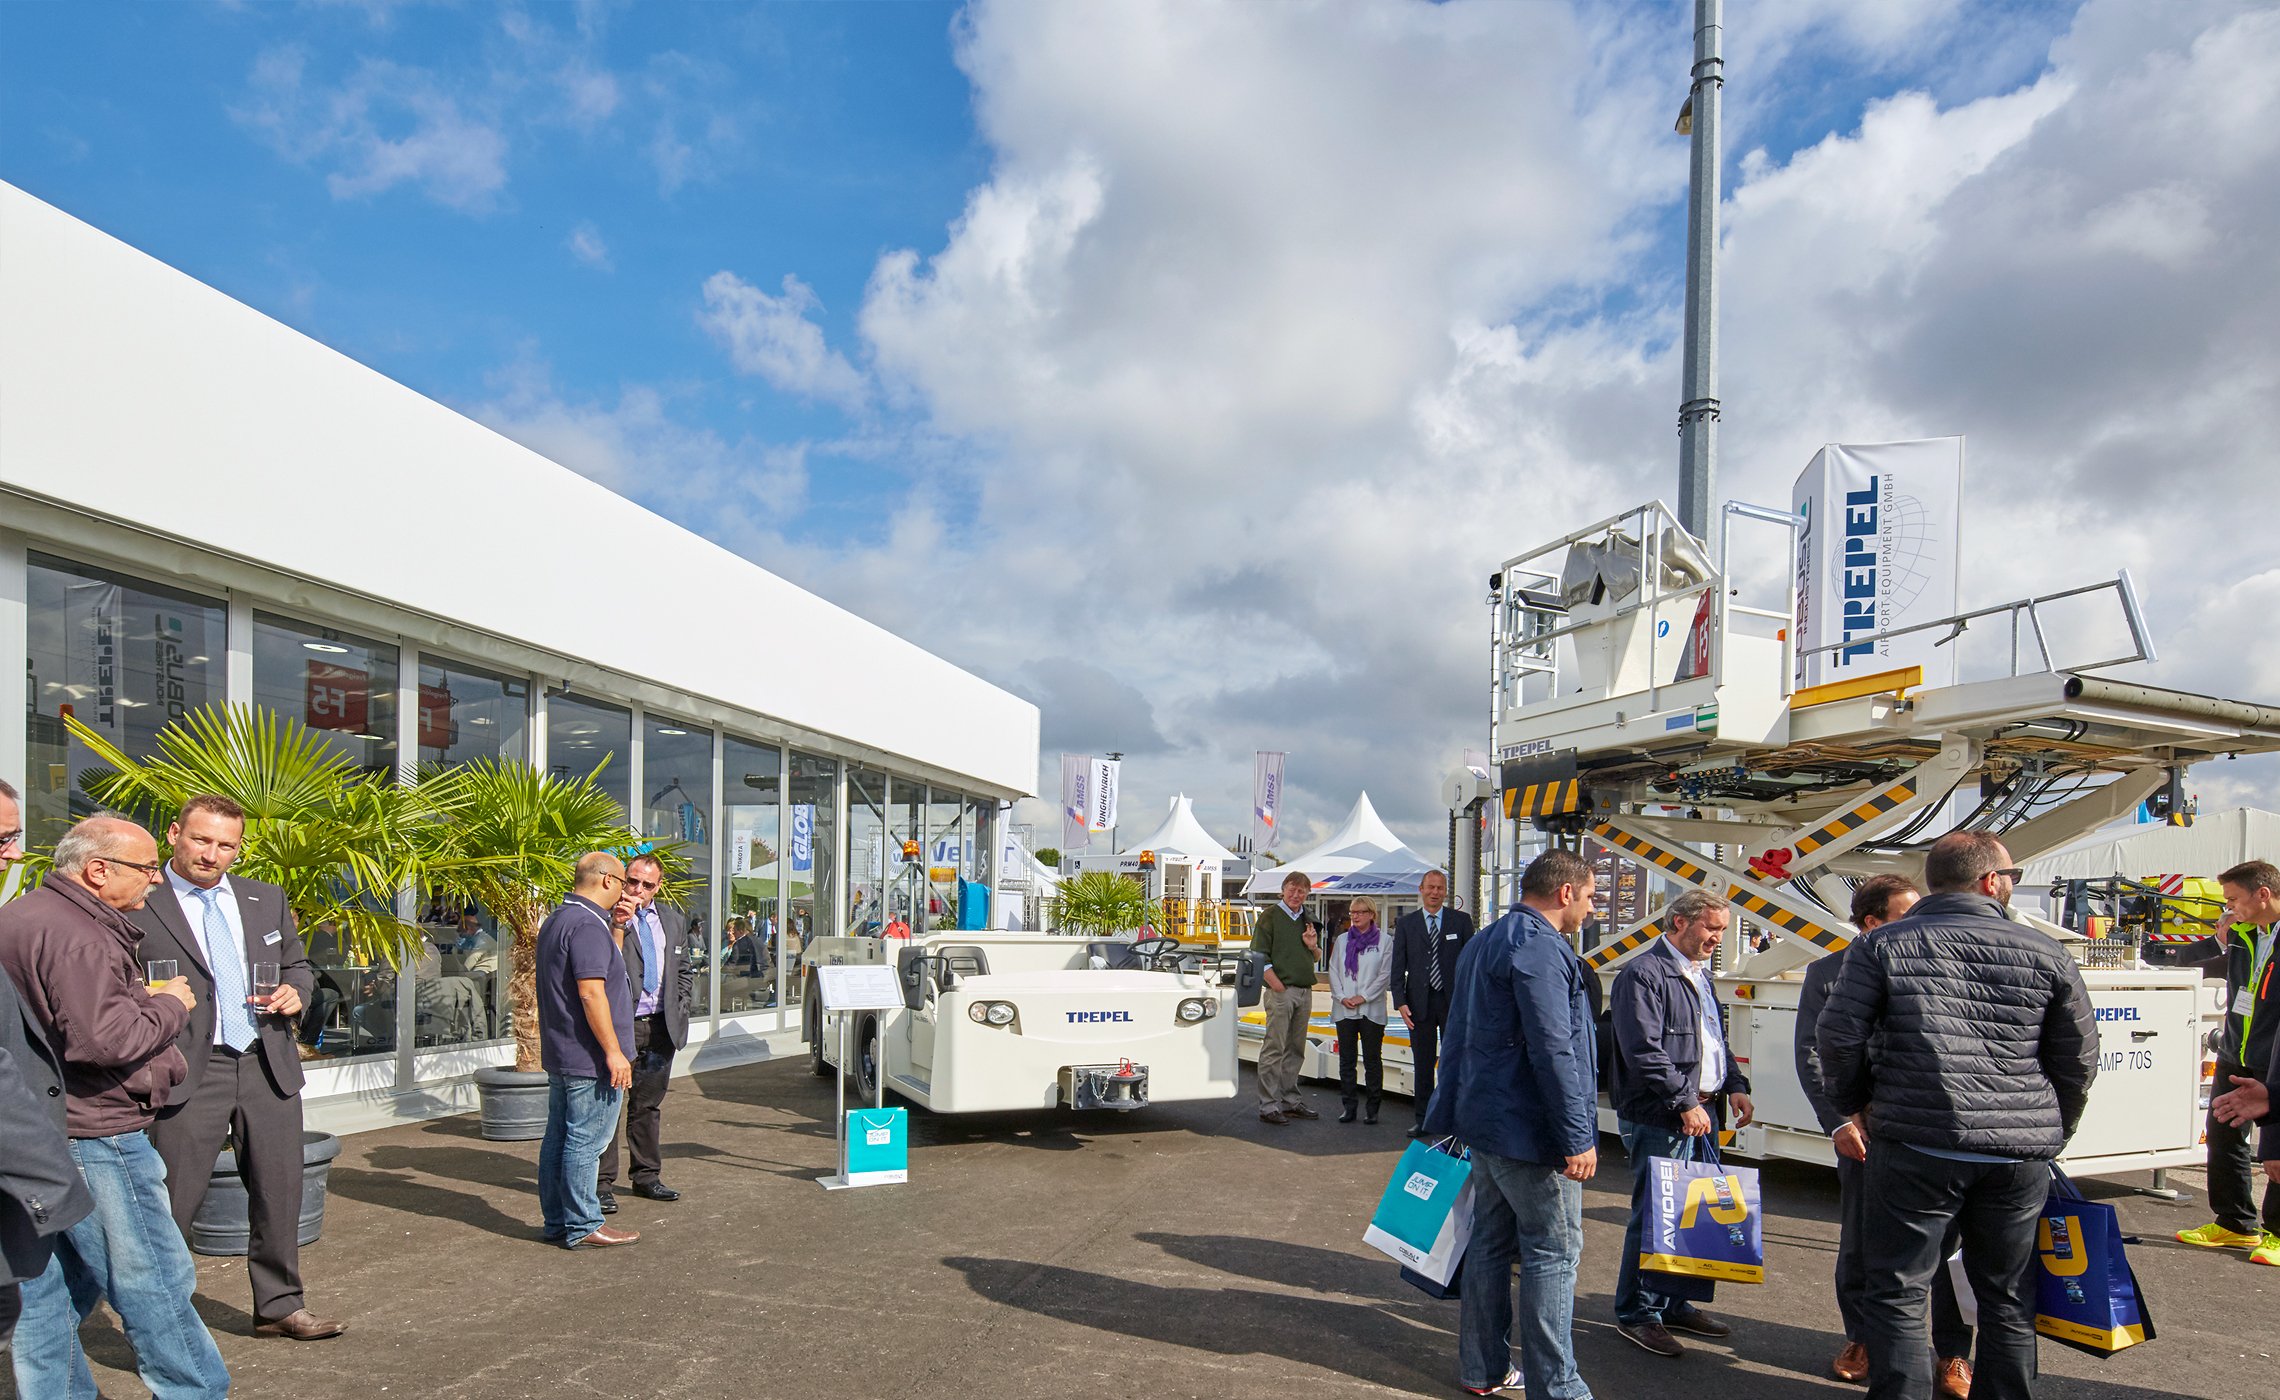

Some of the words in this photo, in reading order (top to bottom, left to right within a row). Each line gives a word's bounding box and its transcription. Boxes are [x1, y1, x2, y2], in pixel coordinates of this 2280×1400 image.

[1884, 473, 1893, 512] GMBH
[1843, 475, 1878, 665] TREPEL
[1882, 519, 1892, 595] EQUIPMENT
[1880, 601, 1890, 657] AIRPORT
[1502, 739, 1553, 759] TREPEL
[1076, 774, 1085, 809] AMSS
[1096, 764, 1109, 828] JUNGHEINRICH
[1265, 772, 1275, 809] AMSS
[1339, 880, 1396, 889] AMSS
[1065, 1011, 1134, 1023] TREPEL
[2128, 1050, 2152, 1070] 70S
[1407, 1181, 1420, 1191] ON
[1411, 1175, 1434, 1188] JUMP
[1660, 1161, 1676, 1251] AVIOGEI
